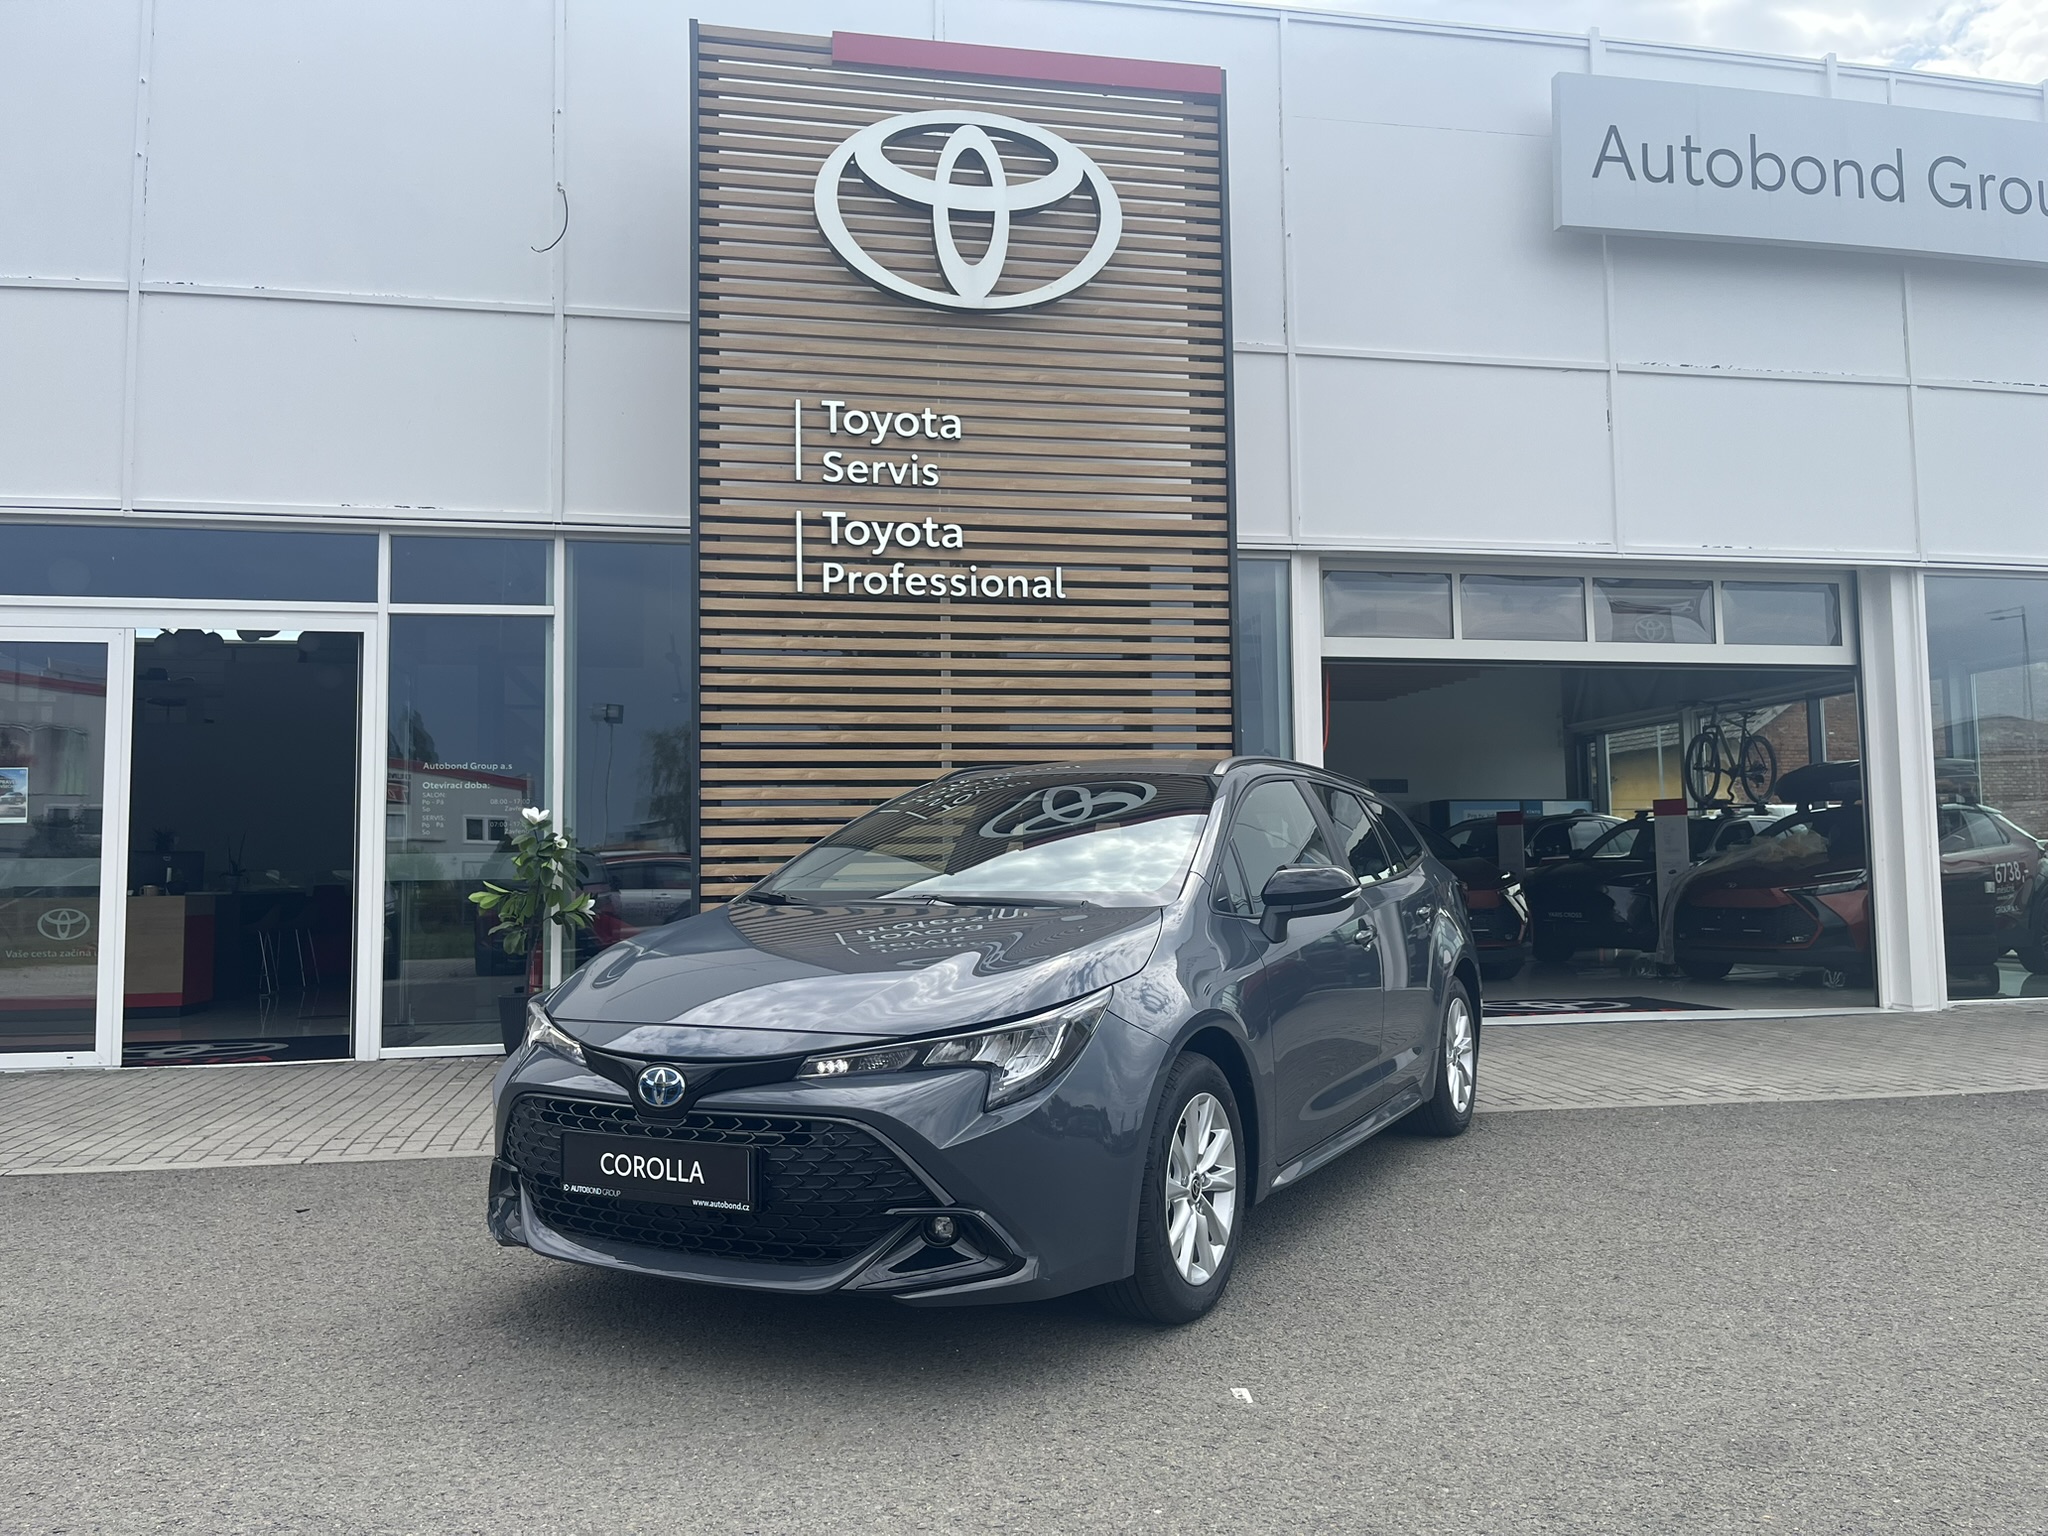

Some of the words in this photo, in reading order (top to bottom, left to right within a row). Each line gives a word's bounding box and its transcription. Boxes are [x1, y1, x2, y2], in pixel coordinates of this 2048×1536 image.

[1591, 124, 1905, 203] Autobond
[821, 400, 962, 445] Toyota
[822, 451, 939, 486] Servis
[821, 511, 964, 555] Toyota
[822, 562, 1066, 599] Professional
[423, 762, 468, 770] Autobond
[470, 762, 499, 771] Group
[464, 781, 490, 790] doba:
[5, 949, 29, 958] Vaše
[31, 950, 58, 958] cesta
[59, 948, 92, 958] začíná
[600, 1152, 705, 1185] COROLLA
[570, 1184, 602, 1195] AUTOBOND
[602, 1188, 622, 1197] GROUP
[692, 1199, 750, 1212] www.autobond.cz
